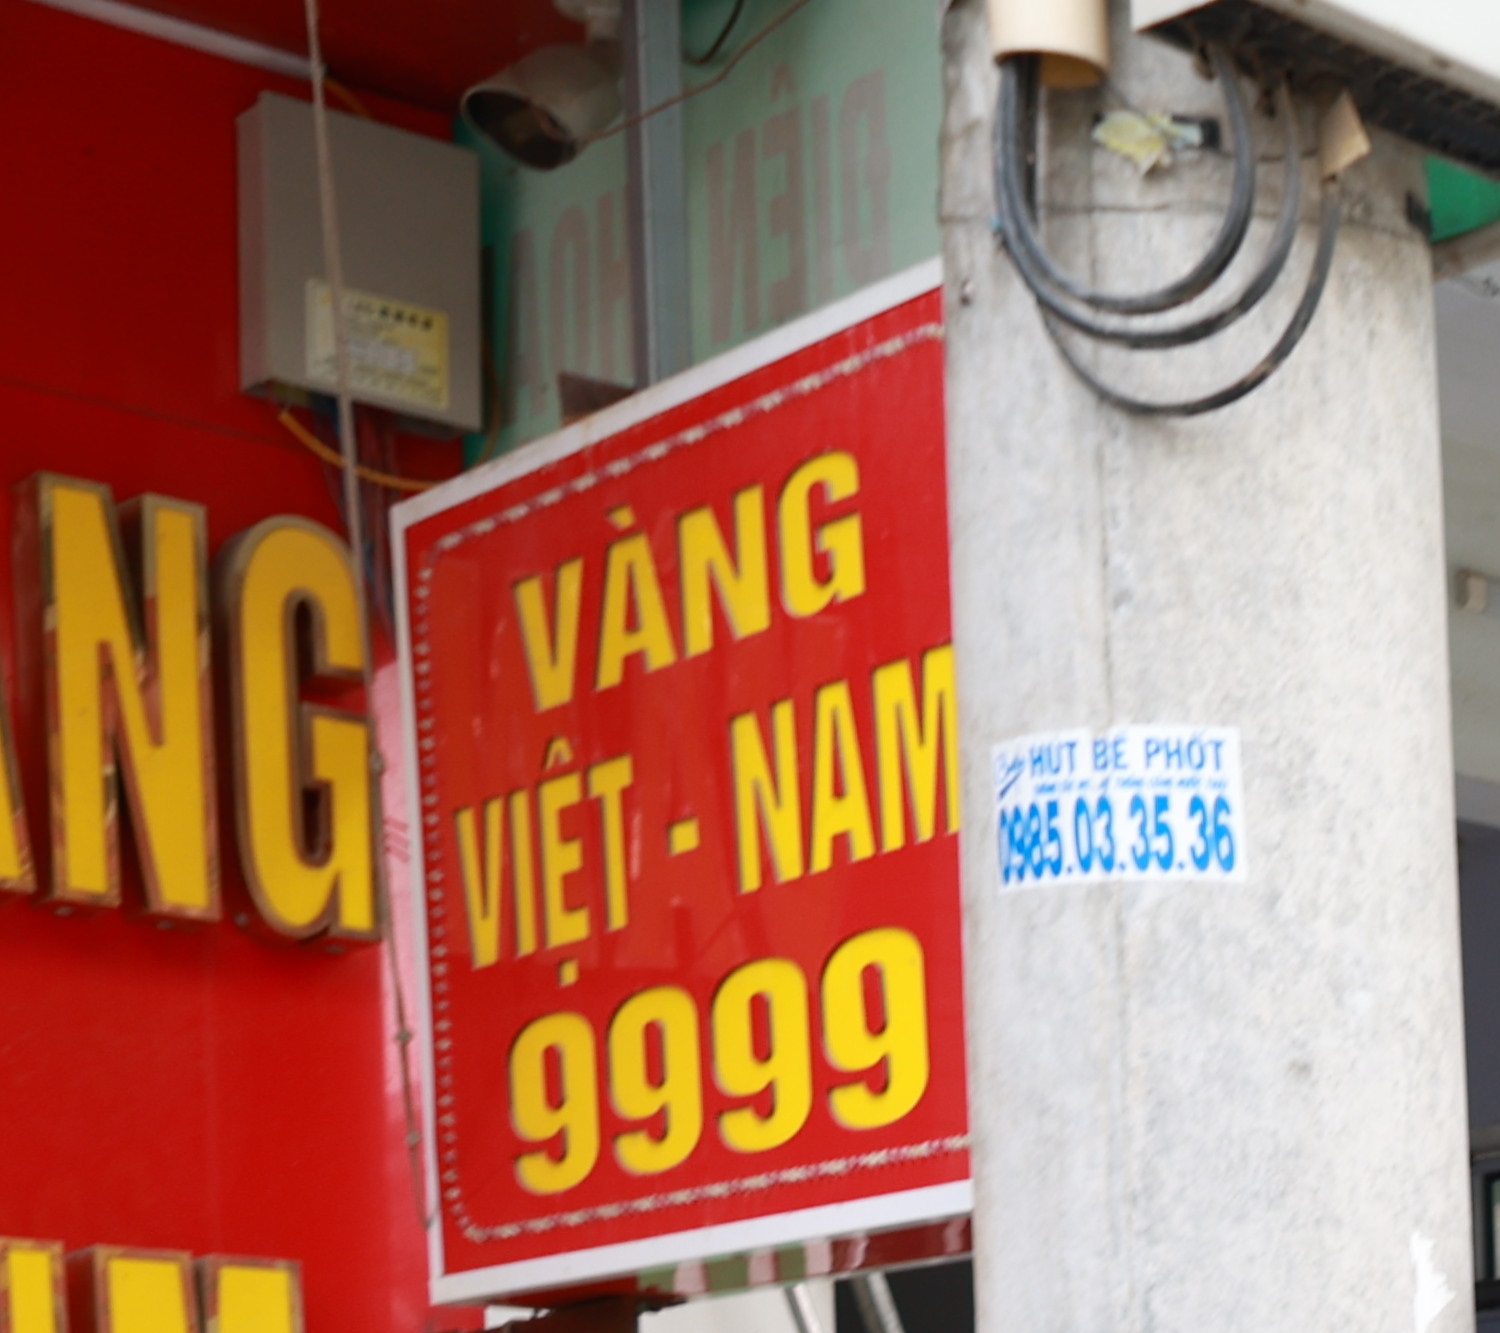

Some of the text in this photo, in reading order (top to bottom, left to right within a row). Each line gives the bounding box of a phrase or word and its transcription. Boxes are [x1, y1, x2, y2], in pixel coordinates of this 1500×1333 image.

[513, 450, 865, 713] VÀNG
[453, 736, 632, 987] VIỆT
[727, 642, 959, 895] NAM
[506, 926, 930, 1196] 9999
